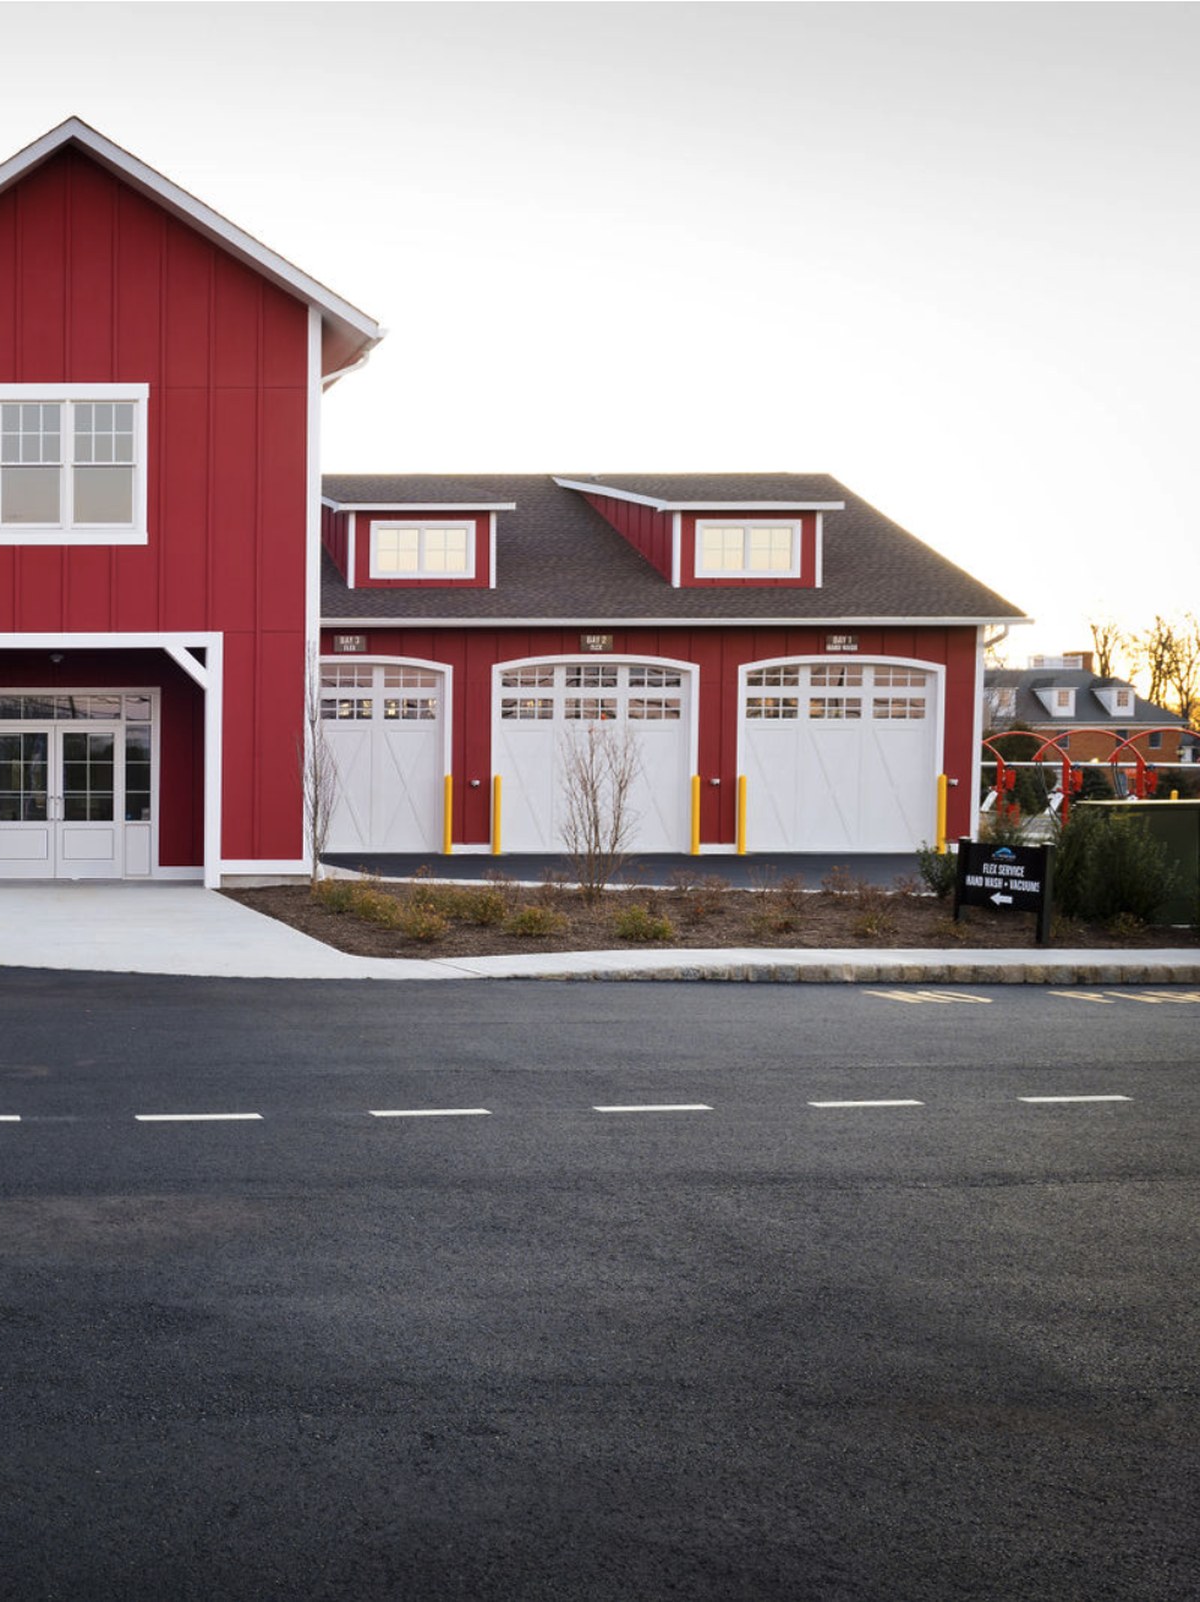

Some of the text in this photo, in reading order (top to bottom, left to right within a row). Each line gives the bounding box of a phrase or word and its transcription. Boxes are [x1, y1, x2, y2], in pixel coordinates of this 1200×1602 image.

[982, 863, 1025, 878] FLEX SERVICE
[965, 875, 1040, 893] HAND WASH VACUUMS
